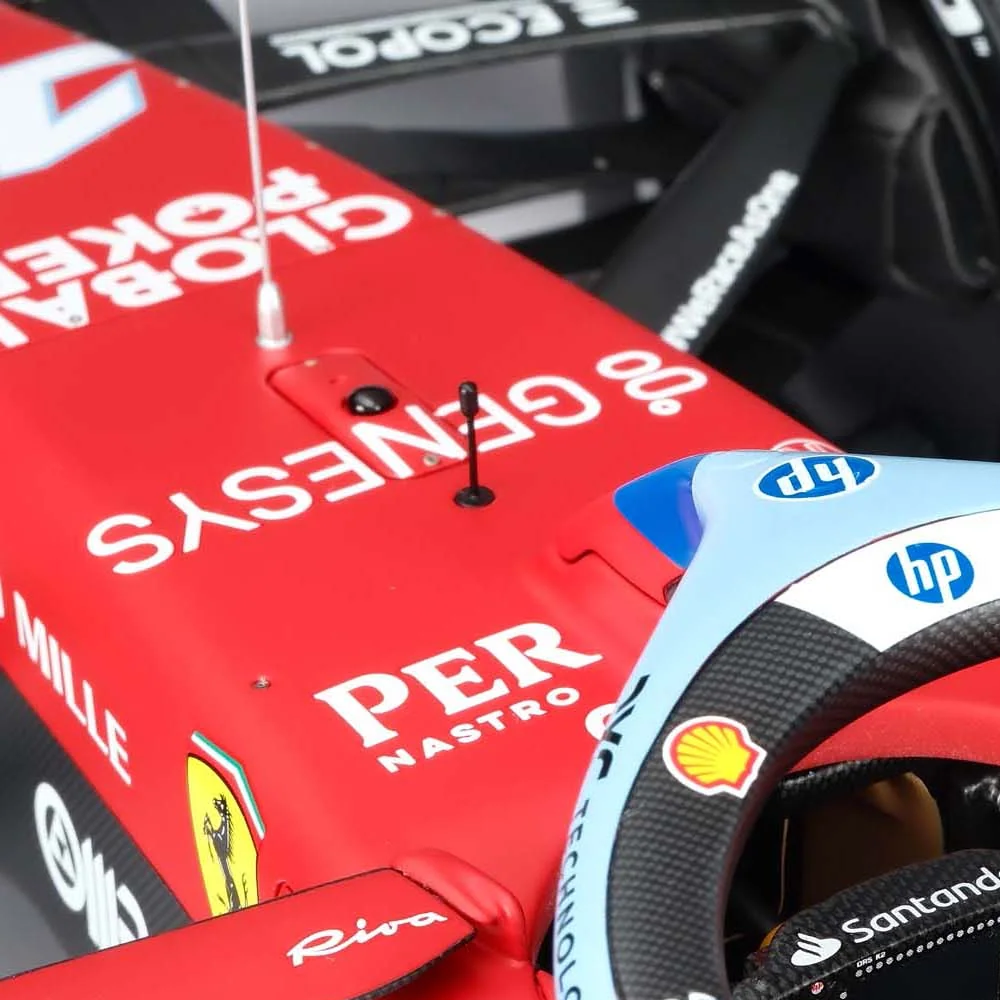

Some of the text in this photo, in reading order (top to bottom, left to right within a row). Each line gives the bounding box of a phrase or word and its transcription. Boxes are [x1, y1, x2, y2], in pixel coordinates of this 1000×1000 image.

[86, 374, 603, 576] GENESYS
[775, 455, 870, 498] hp
[893, 545, 968, 604] hp
[13, 590, 133, 787] MILLE
[313, 622, 604, 750] PER
[377, 686, 580, 774] NASTRO
[285, 911, 448, 968] Riva
